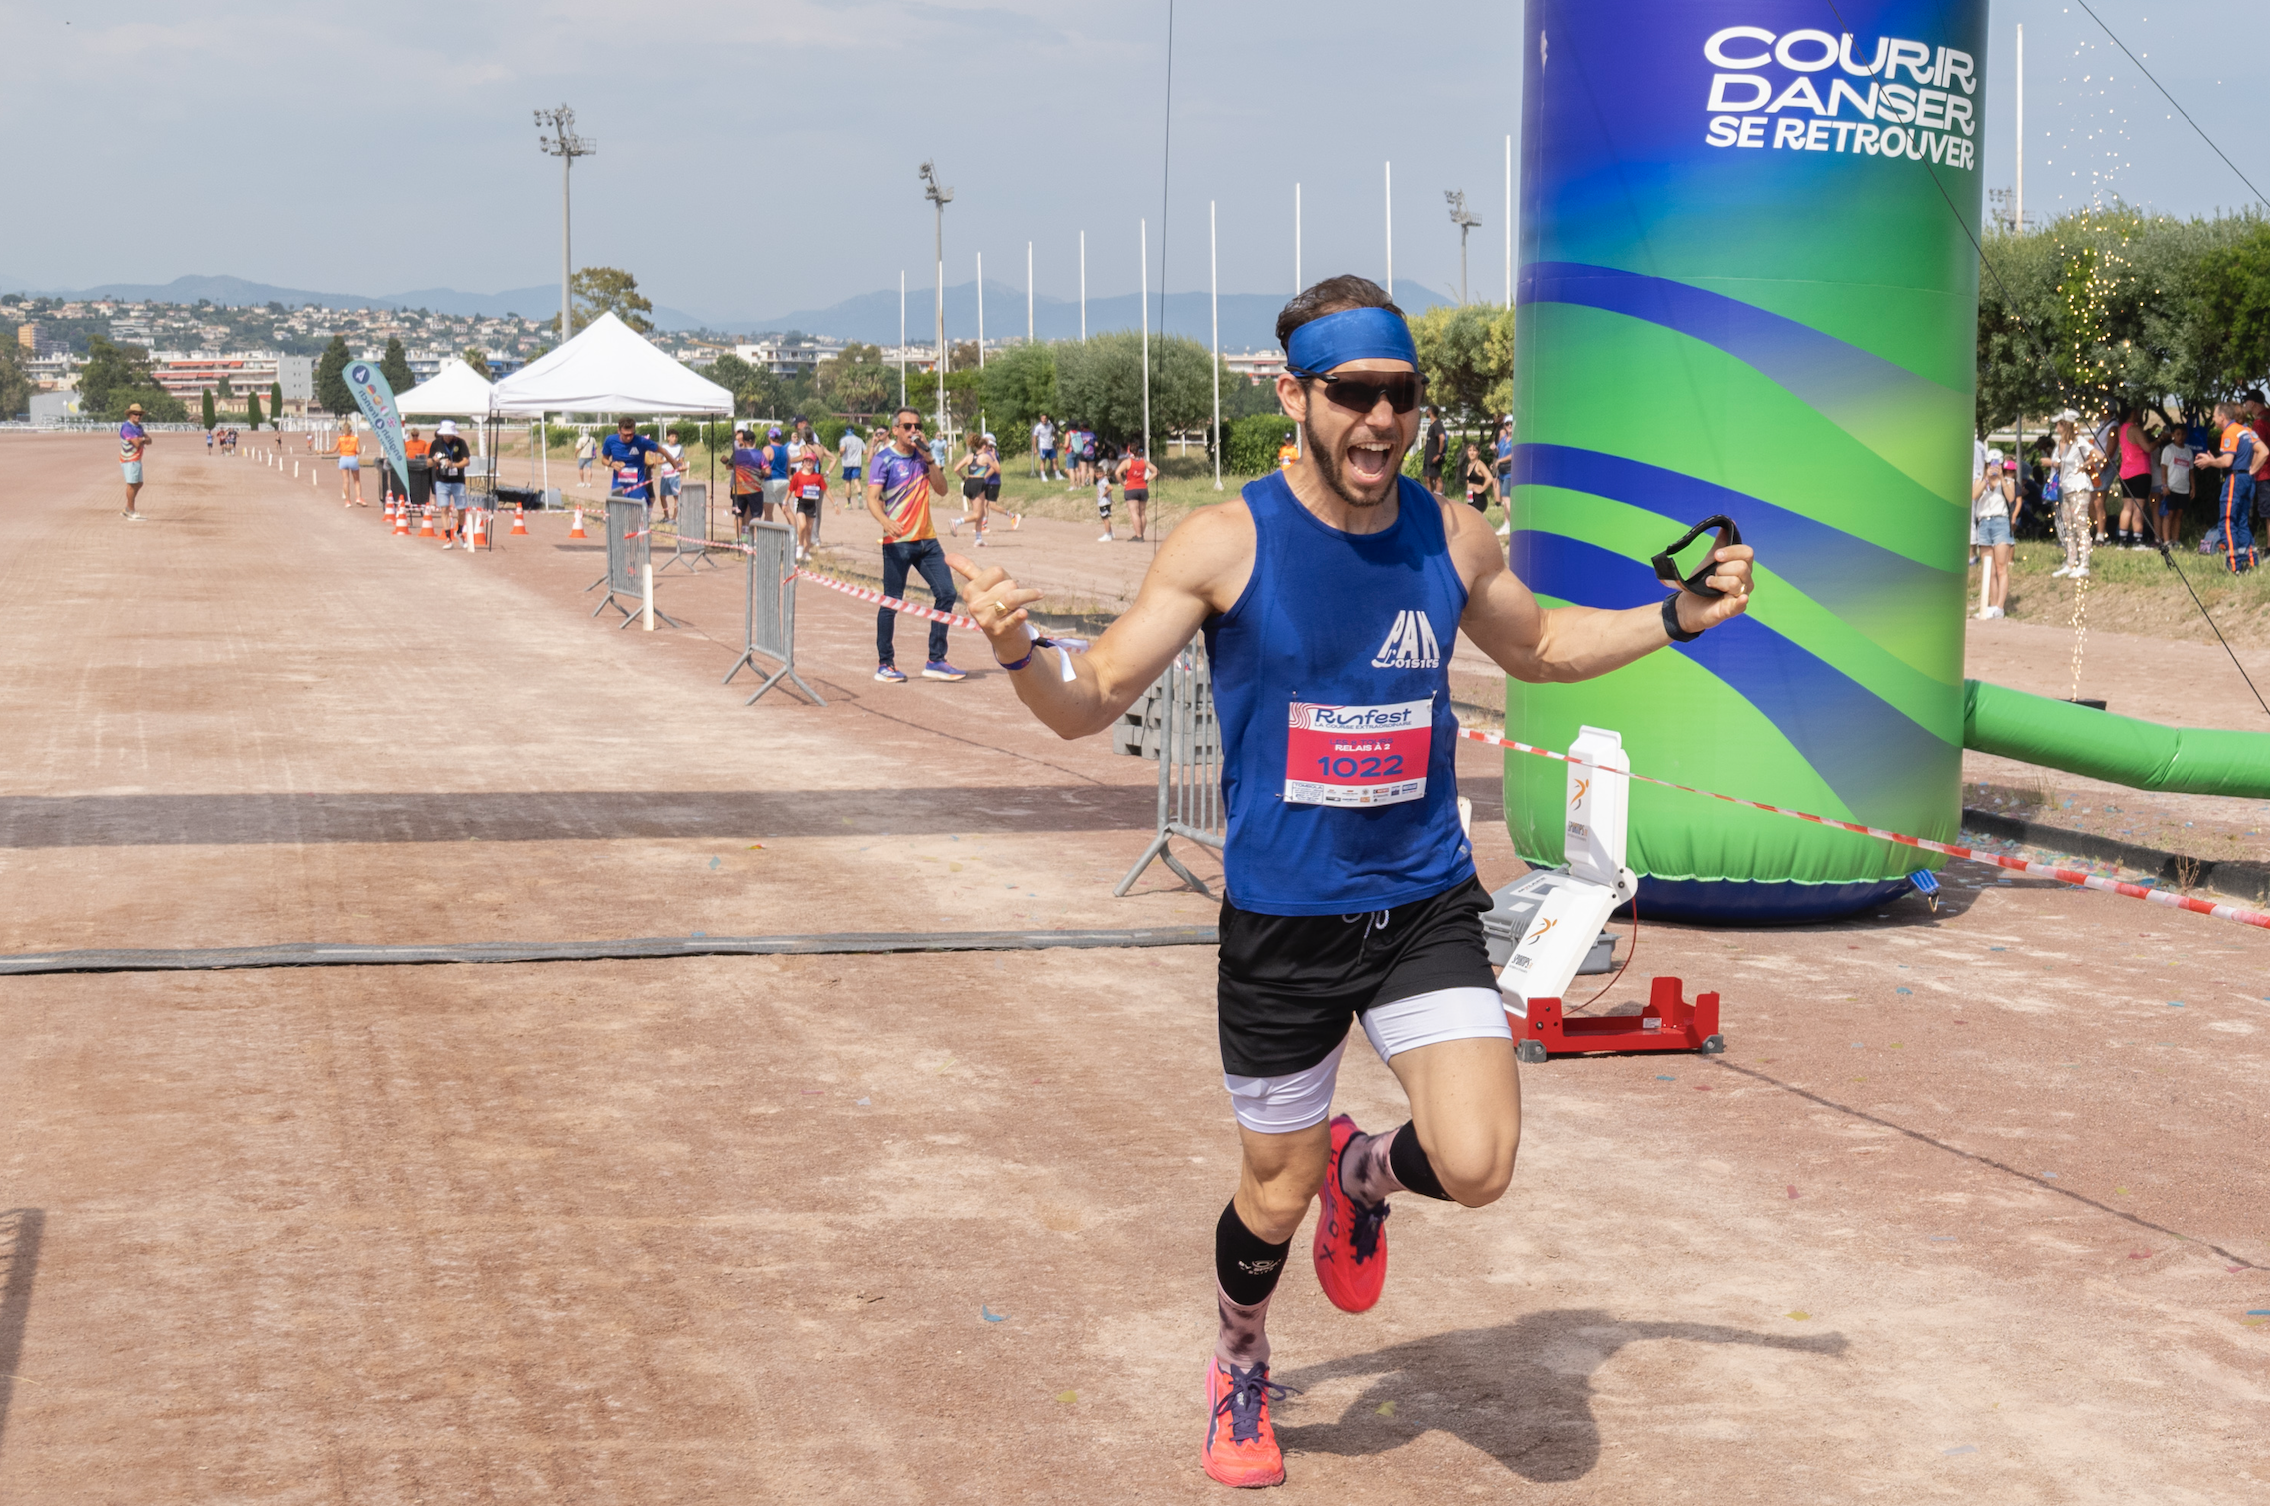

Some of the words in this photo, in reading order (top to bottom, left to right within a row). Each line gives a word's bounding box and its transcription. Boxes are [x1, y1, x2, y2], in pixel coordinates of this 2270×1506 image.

[1704, 26, 1977, 94] COURIR
[1706, 73, 1976, 136] DANSER
[1705, 115, 1768, 148] SE
[1773, 117, 1975, 171] RETROUVER
[1315, 707, 1412, 725] Runfest
[1355, 720, 1412, 730] EXTRAORDINAIRE
[1335, 744, 1373, 752] RELAIS
[1374, 742, 1383, 752] À
[1384, 743, 1391, 751] 2
[1317, 754, 1404, 778] 1022
